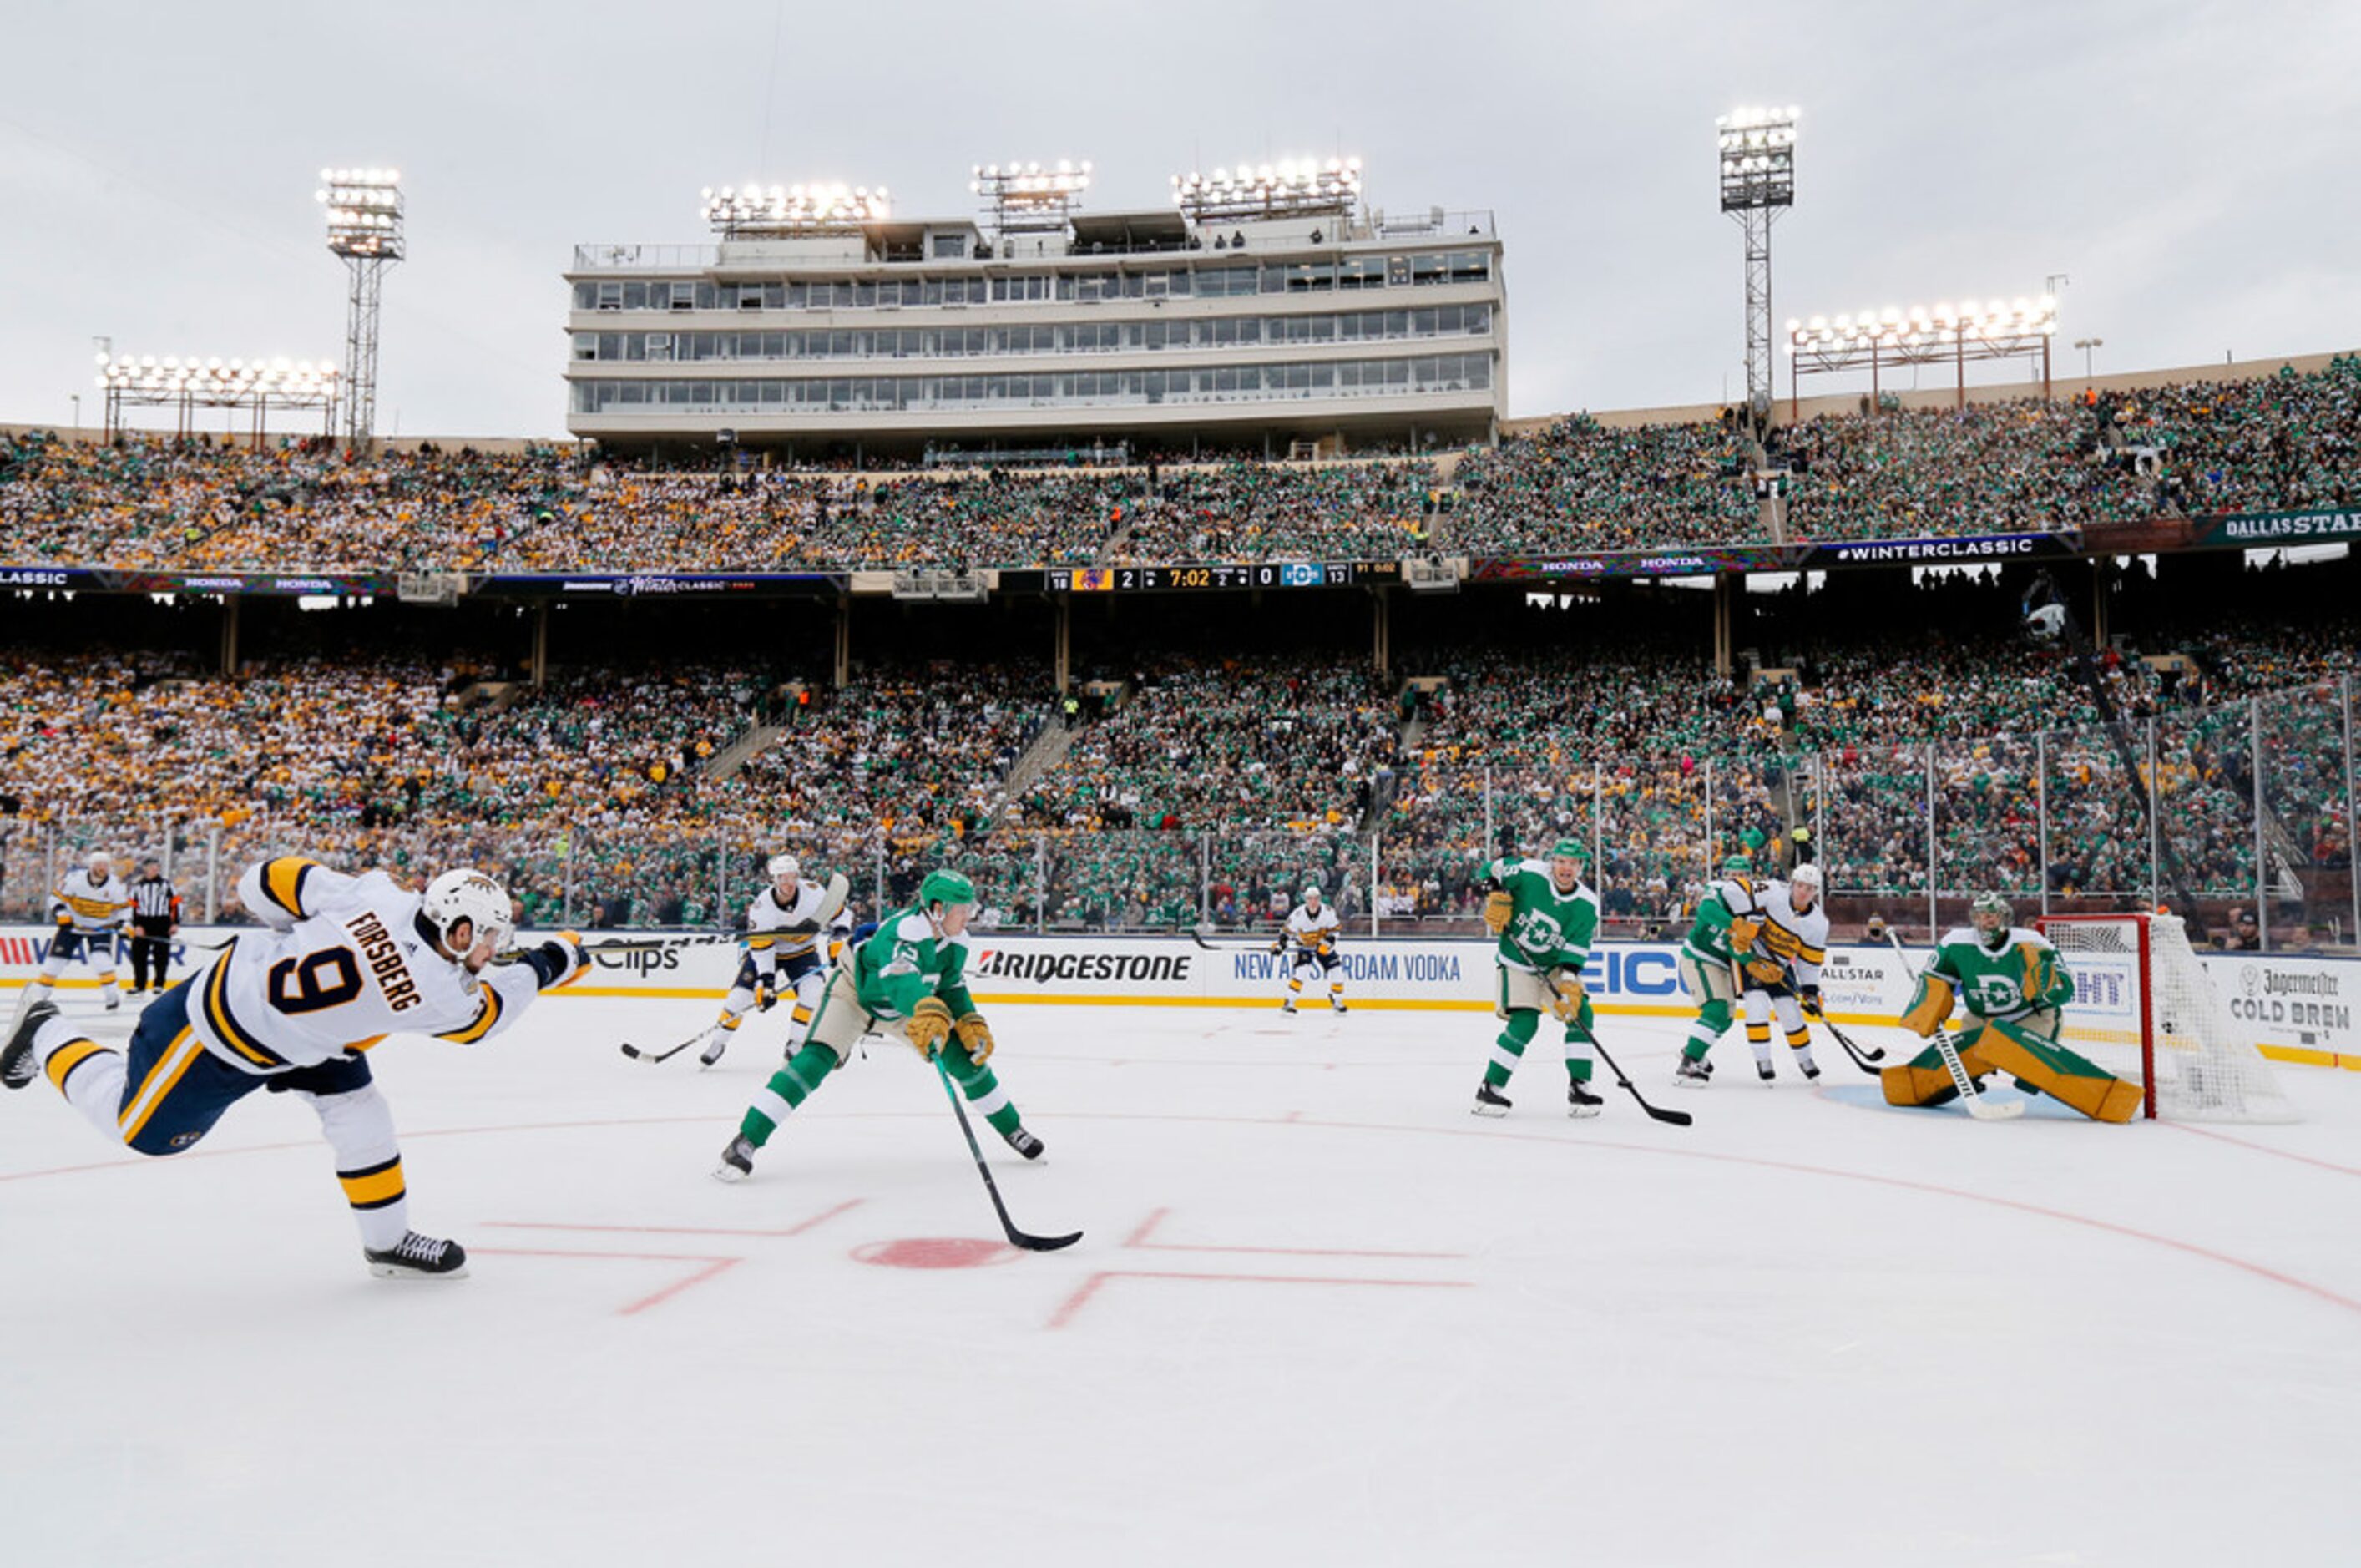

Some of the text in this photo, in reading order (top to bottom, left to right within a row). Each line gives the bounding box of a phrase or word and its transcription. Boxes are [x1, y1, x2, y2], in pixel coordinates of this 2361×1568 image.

[2226, 518, 2291, 536] DALLAS
[1838, 539, 2033, 560] #WINTERCLASSIC
[1542, 560, 1604, 571] HONDA
[1641, 557, 1705, 568] HONDA
[185, 577, 243, 589] HONDA
[276, 579, 332, 589] HONDA
[1122, 571, 1134, 588] 2
[1170, 569, 1210, 587] 7:02
[1219, 574, 1227, 586] 2
[1260, 567, 1272, 584] 0
[1330, 571, 1345, 584] 13
[345, 911, 422, 1014] FORSBERG
[979, 948, 1191, 982] BRIDGESTONE
[1235, 953, 1273, 979] NEW
[1404, 953, 1461, 980] VODKA
[268, 944, 364, 1015] 9
[1580, 952, 1691, 995] EIC
[2230, 998, 2351, 1030] COLD BREW
